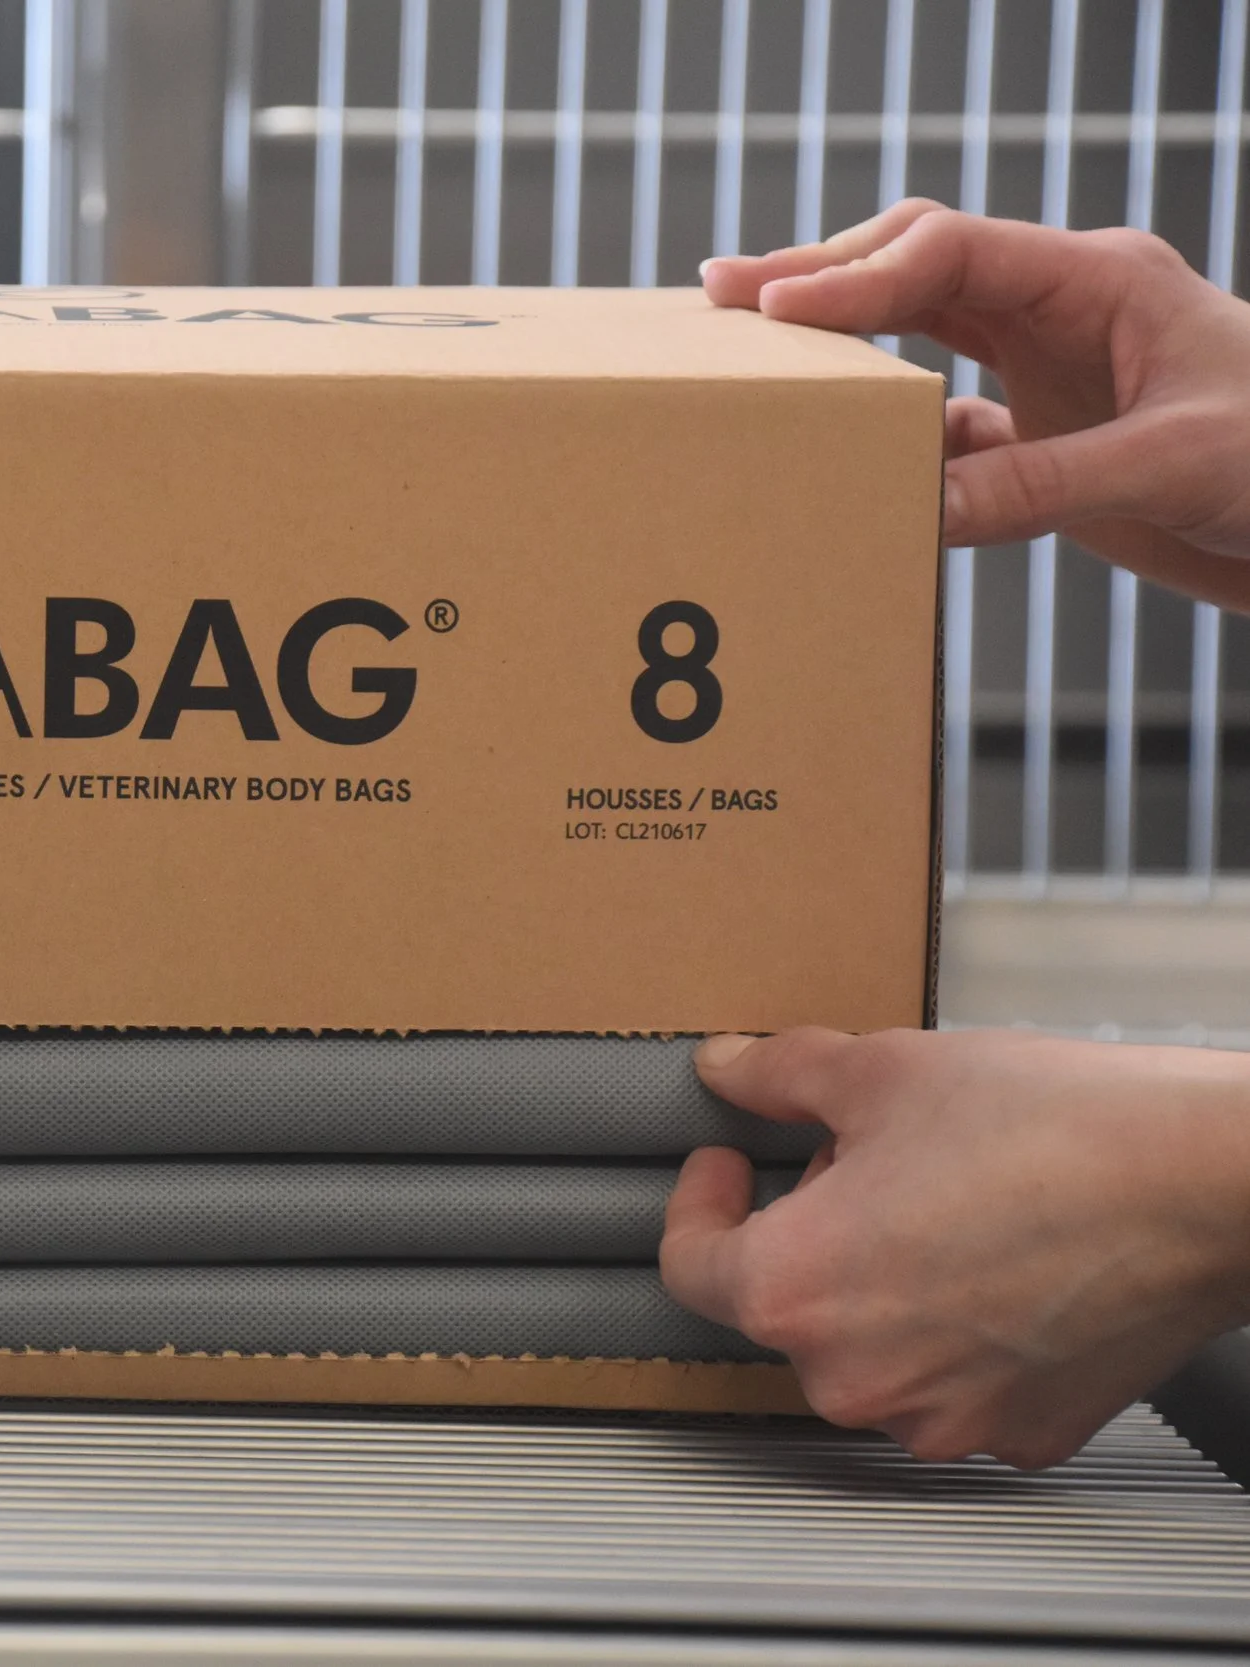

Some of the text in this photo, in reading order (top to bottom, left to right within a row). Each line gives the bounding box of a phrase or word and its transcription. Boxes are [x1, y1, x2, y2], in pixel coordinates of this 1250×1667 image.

[631, 600, 723, 744] 8
[34, 773, 51, 800] /
[58, 774, 238, 801] VETERINARY
[246, 777, 327, 802] BODY
[335, 778, 412, 803] BAGS
[567, 787, 683, 811] HOUSSES
[710, 788, 779, 812] BAGS
[565, 821, 708, 841] LOT: CL210617
